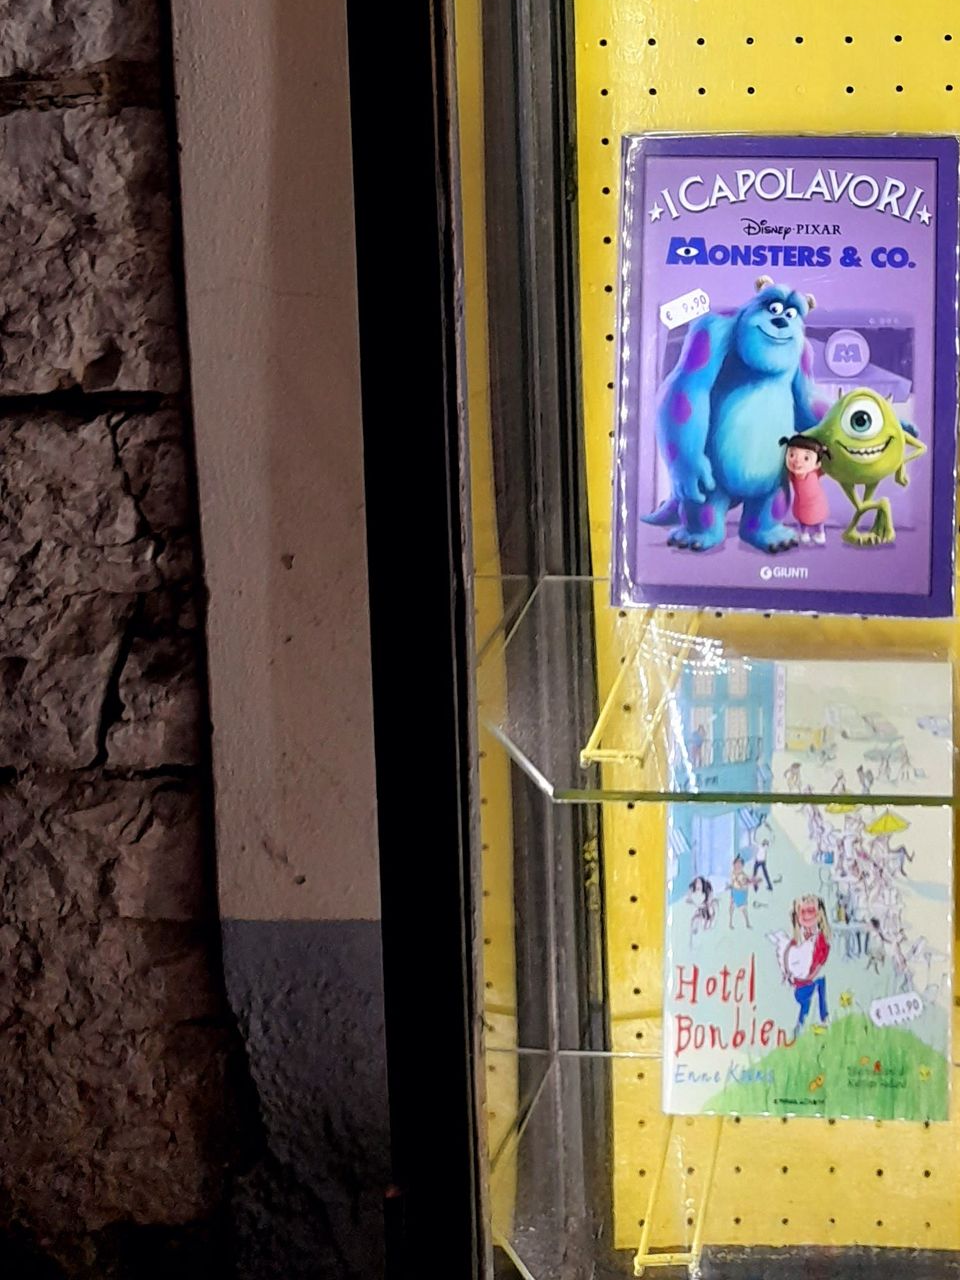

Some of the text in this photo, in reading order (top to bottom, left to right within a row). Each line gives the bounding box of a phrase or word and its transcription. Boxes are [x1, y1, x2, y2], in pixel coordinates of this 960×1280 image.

[660, 167, 925, 222] I CAPOLAVORI
[796, 224, 842, 236] PIXAR
[665, 236, 917, 269] MONSTERS & CO.
[772, 566, 809, 579] GIUNTI
[675, 952, 755, 1006] Hotel
[674, 1005, 798, 1057] Bonbien
[674, 1063, 721, 1084] Enne
